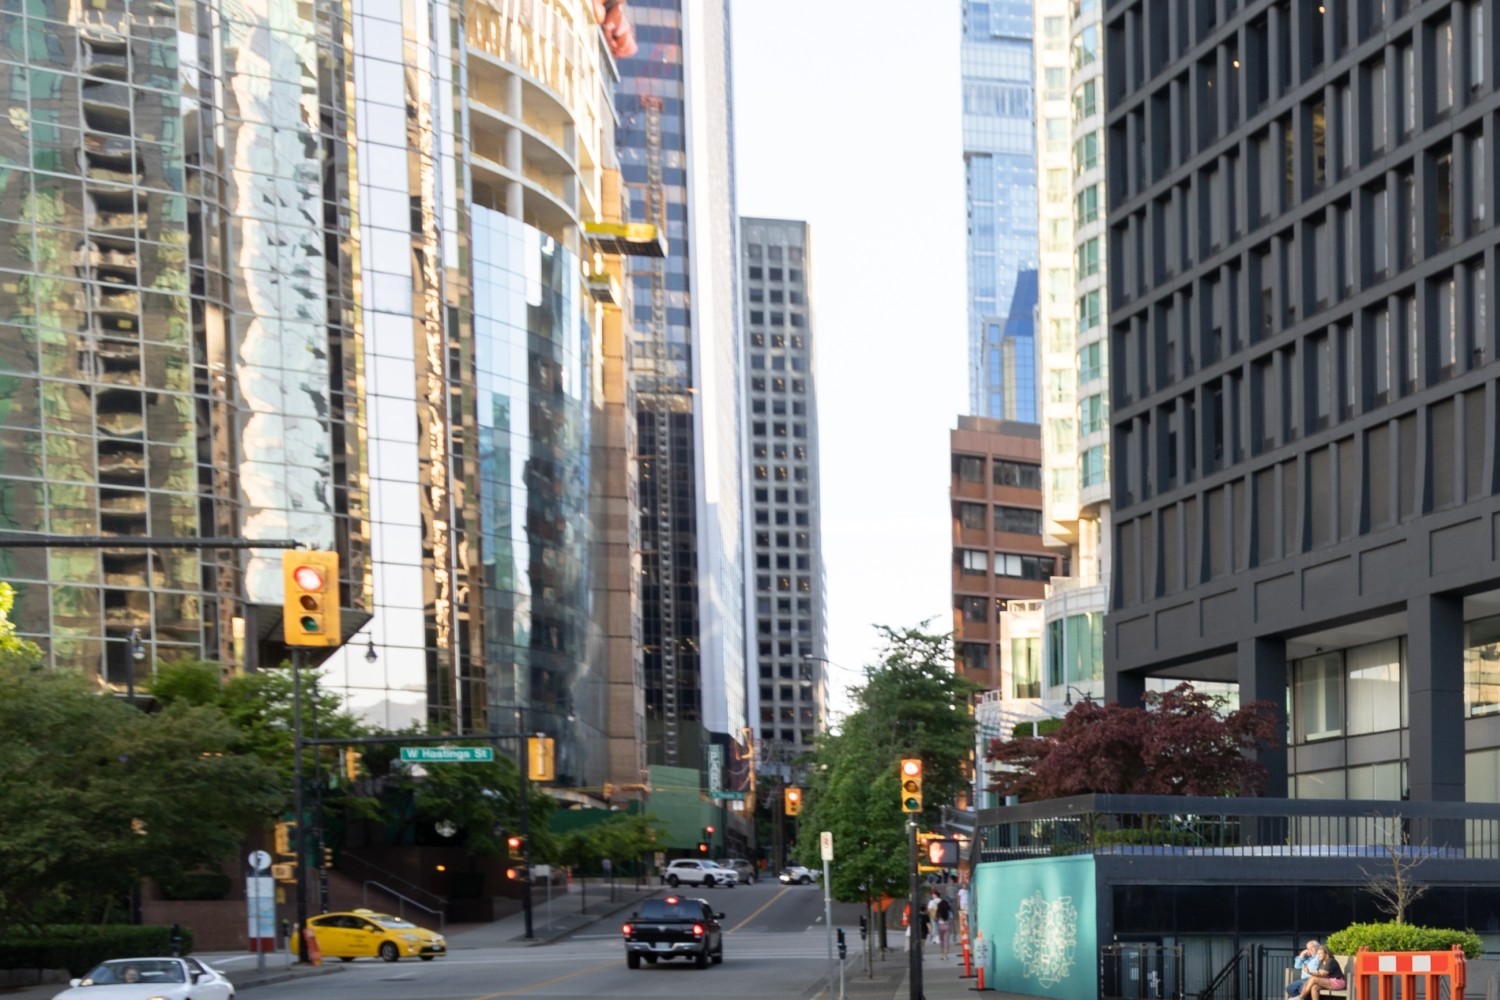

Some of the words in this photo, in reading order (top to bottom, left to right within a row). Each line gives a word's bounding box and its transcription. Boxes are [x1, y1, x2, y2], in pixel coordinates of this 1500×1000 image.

[406, 748, 419, 759] W
[421, 748, 471, 761] Hastings
[473, 748, 488, 759] St
